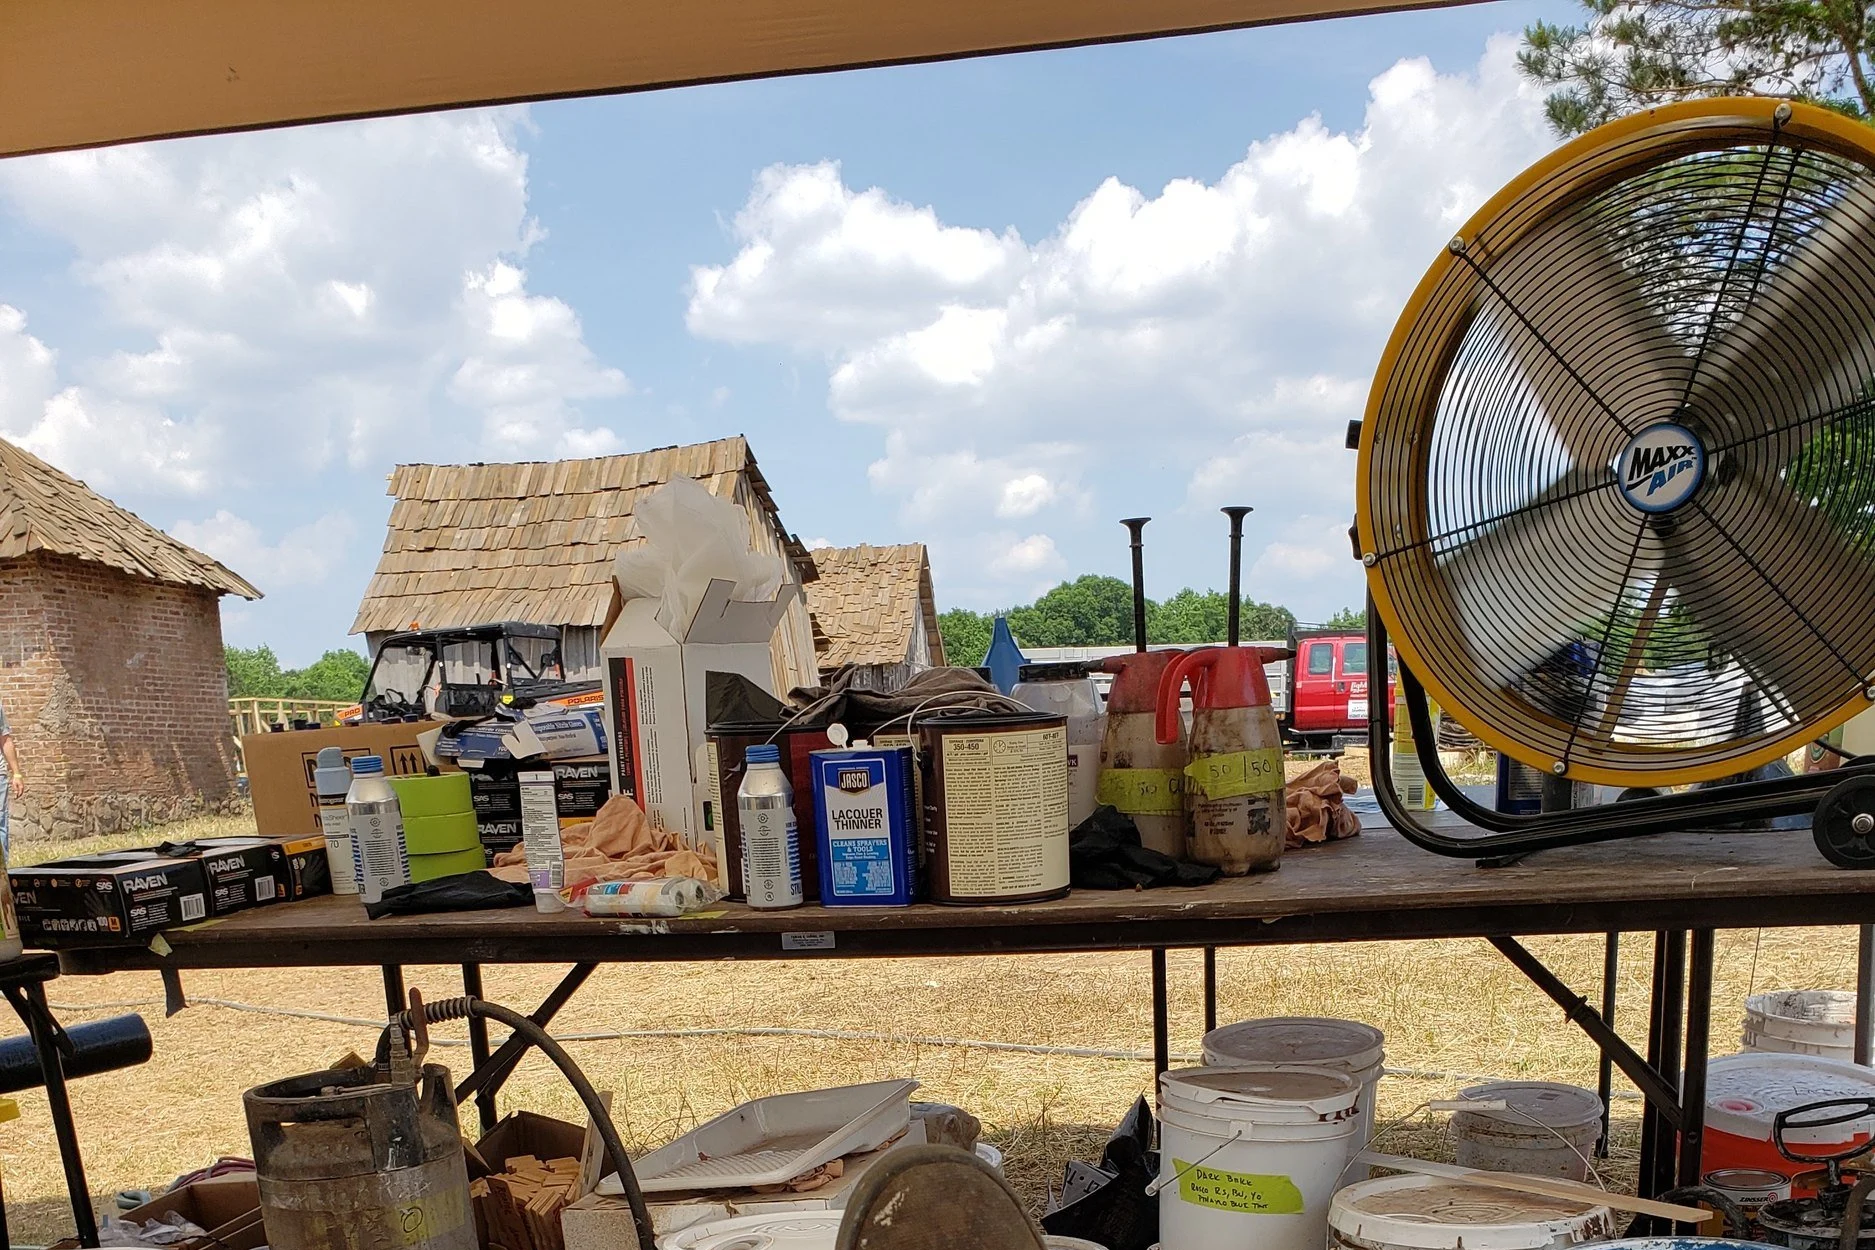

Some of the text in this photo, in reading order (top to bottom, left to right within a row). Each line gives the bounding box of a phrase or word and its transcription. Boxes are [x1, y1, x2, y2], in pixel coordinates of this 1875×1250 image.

[1628, 445, 1696, 481] MAXX
[1647, 460, 1694, 497] AIR
[567, 694, 605, 705] POLARIS
[344, 707, 361, 717] PRO
[953, 742, 980, 751] 350-450
[555, 765, 599, 779] RAVEN
[1210, 763, 1232, 778] 50
[1251, 759, 1272, 777] 50
[841, 772, 868, 789] JASCO
[558, 793, 574, 801] SAS
[832, 808, 883, 820] LACQUER
[835, 819, 882, 831] THINNER
[328, 839, 340, 849] 70
[833, 839, 888, 848] CLEANS SPRAYERS
[207, 855, 246, 876] RAVEN
[96, 881, 113, 892] SAS
[122, 871, 168, 895] RAVEN
[215, 887, 229, 897] SAS
[130, 906, 147, 917] SAS
[1196, 1169, 1221, 1182] DARK
